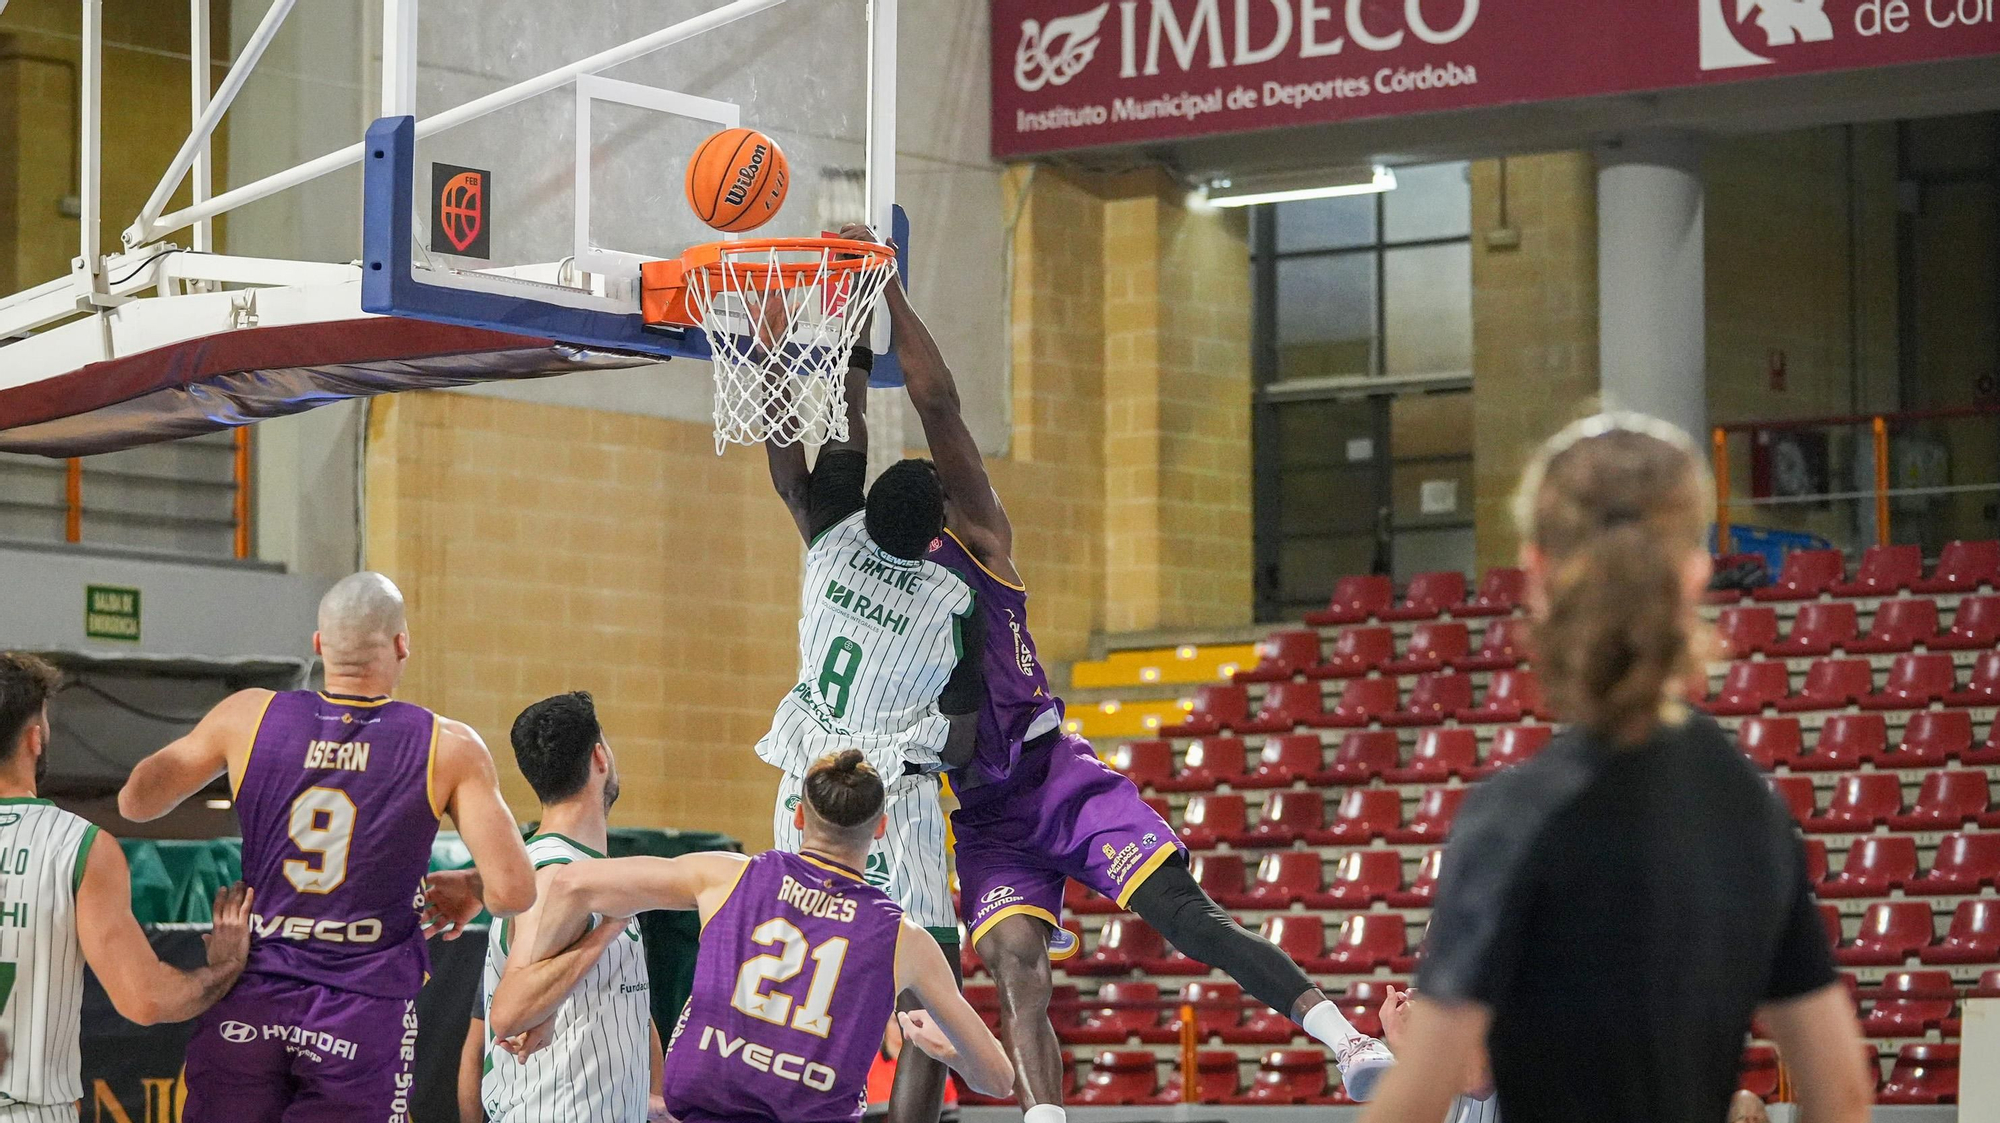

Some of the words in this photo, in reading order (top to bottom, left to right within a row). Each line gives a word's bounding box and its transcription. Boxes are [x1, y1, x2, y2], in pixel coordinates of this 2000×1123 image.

[1119, 0, 1480, 78] IMDECO
[1854, 0, 1910, 36] de
[1016, 104, 1106, 132] Instituto
[1112, 88, 1222, 123] Municipal
[1227, 85, 1257, 110] de
[1262, 73, 1370, 108] Deportes
[1375, 61, 1478, 95] Córdoba
[465, 176, 478, 186] FEB
[724, 143, 767, 207] Wilson
[849, 550, 923, 596] LAMINE
[821, 600, 850, 618] SOLUCIONES
[850, 615, 880, 633] INTEGRALES
[852, 594, 910, 636] RAHI
[818, 636, 863, 718] 8
[304, 739, 371, 772] ISERN
[283, 785, 358, 895] 9
[1107, 842, 1136, 877] ALIMENTOS
[777, 874, 858, 923] ARQUÉS
[977, 895, 1024, 919] HYUNDAI
[249, 913, 382, 943] IVECO
[731, 917, 849, 1039] 21
[698, 1025, 836, 1092] IVECO
